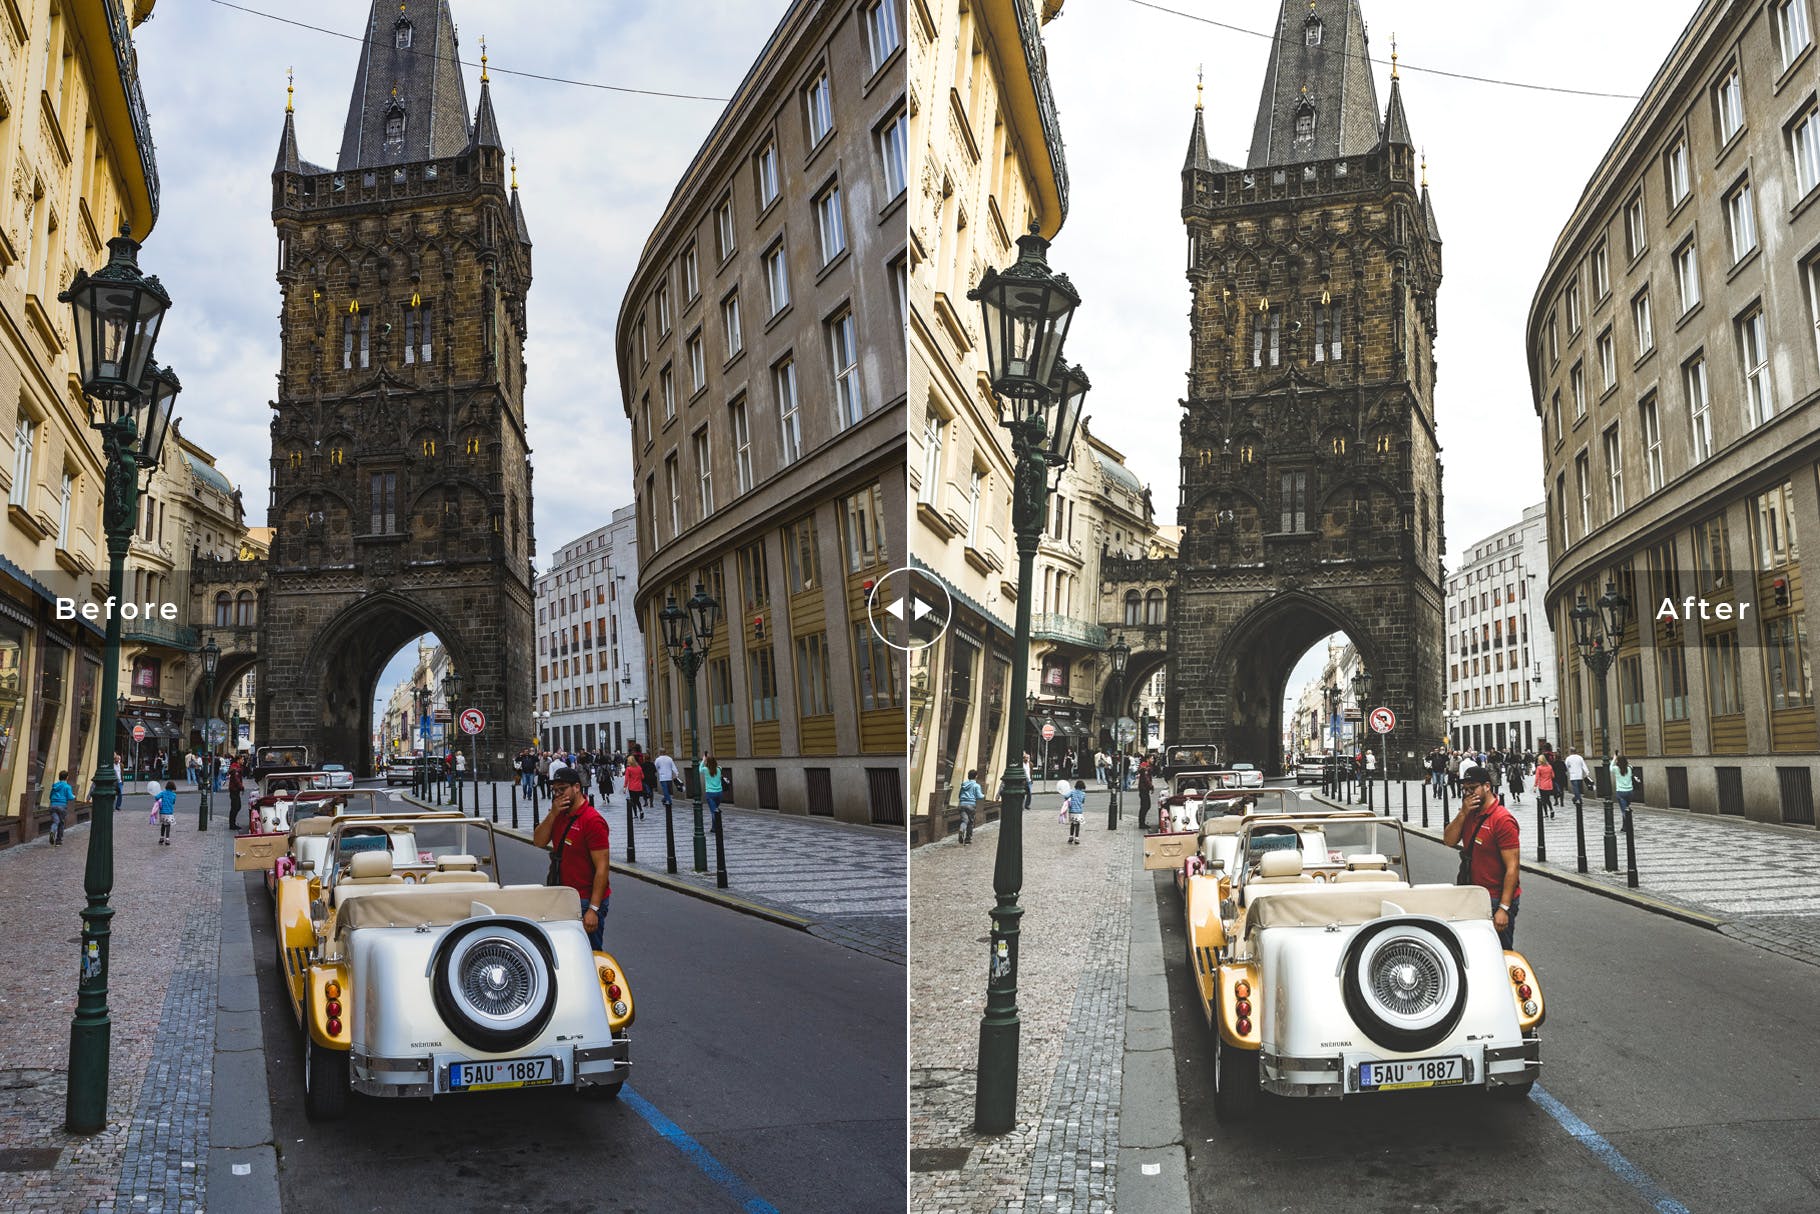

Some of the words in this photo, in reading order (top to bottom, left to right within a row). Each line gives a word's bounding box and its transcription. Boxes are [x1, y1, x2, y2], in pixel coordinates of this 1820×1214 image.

[464, 1064, 494, 1084] 5AU
[507, 1061, 545, 1081] 1887
[1374, 1064, 1404, 1084] 5AU
[1417, 1061, 1455, 1081] 1887
